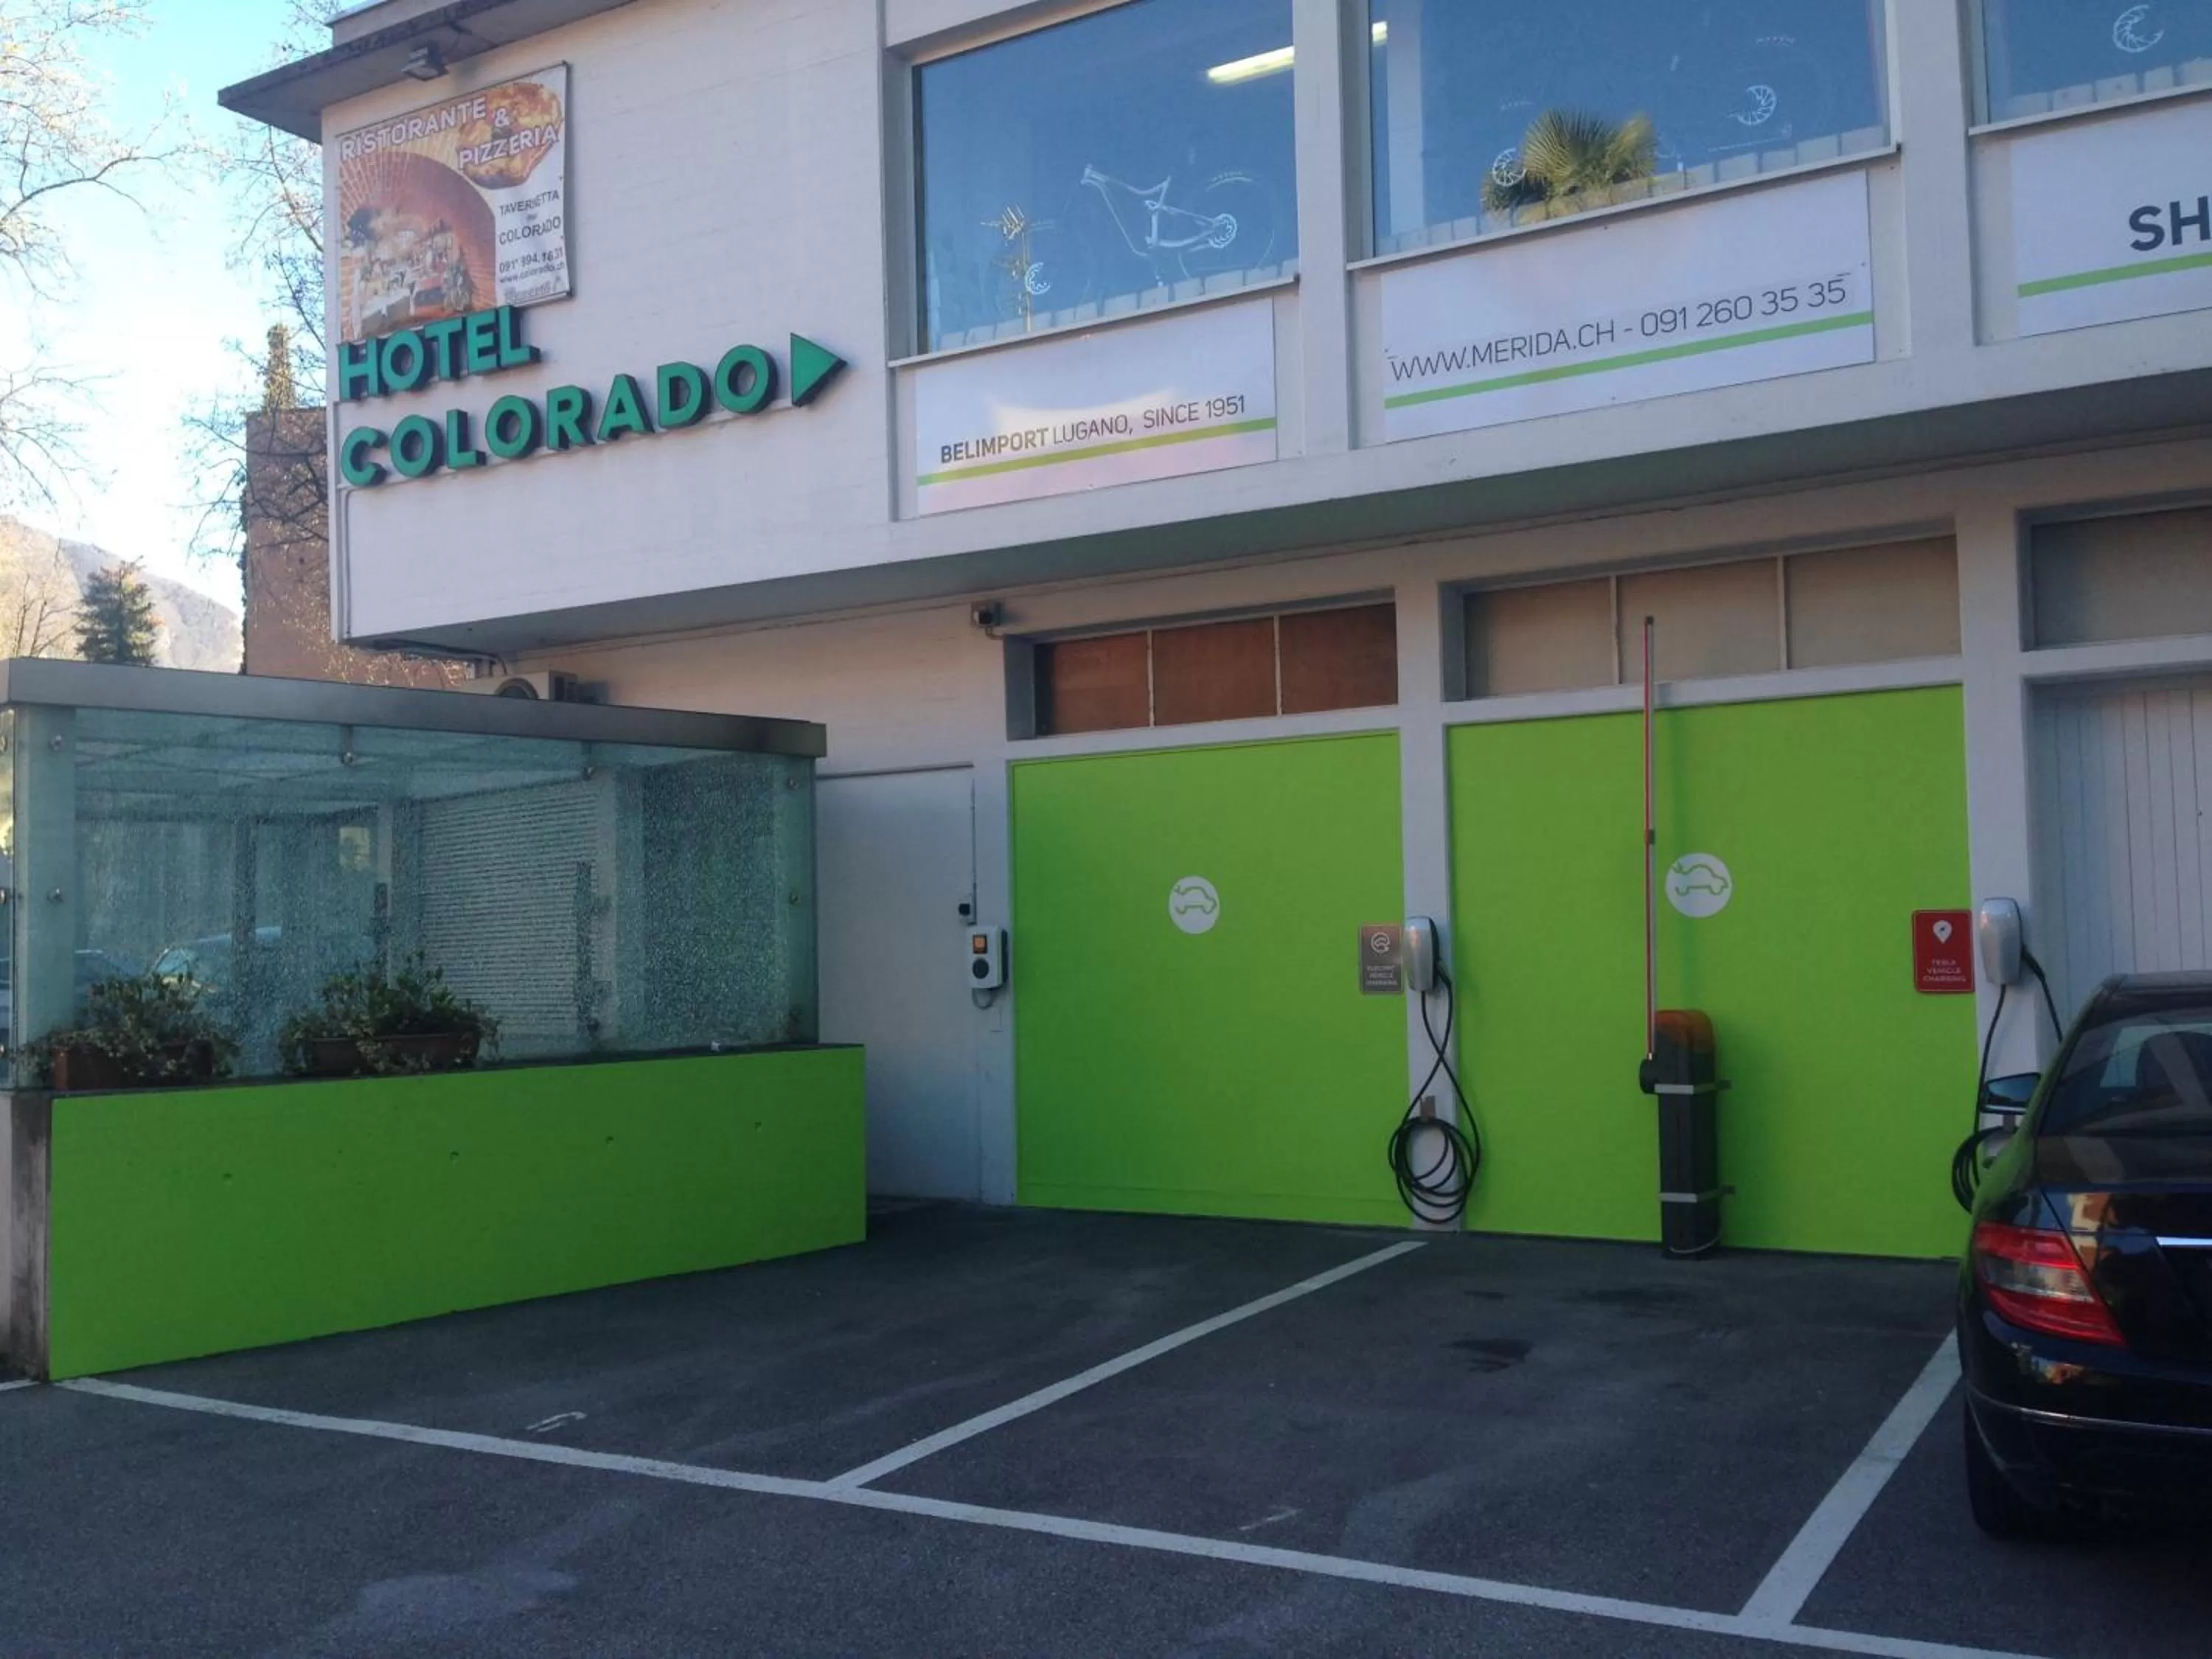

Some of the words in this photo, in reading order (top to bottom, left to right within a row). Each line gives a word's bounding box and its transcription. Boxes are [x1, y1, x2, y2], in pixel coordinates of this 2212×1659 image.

[341, 97, 487, 161] RISTORANTE
[494, 106, 510, 128] &
[459, 125, 561, 169] PIZZERIA
[499, 215, 561, 246] COLORADO
[338, 305, 540, 401] HOTEL
[1391, 319, 1615, 381] WWW.MERIDA.CH
[1641, 306, 1688, 337] 091
[1696, 295, 1752, 327] 260
[1762, 286, 1798, 316] 35
[1807, 278, 1846, 307] 35
[341, 344, 778, 487] COLORADO
[941, 427, 1048, 464] BELIMPORT
[1053, 414, 1133, 444] LUGANO,
[1144, 402, 1200, 430] SINCE
[1205, 394, 1245, 420] 1951
